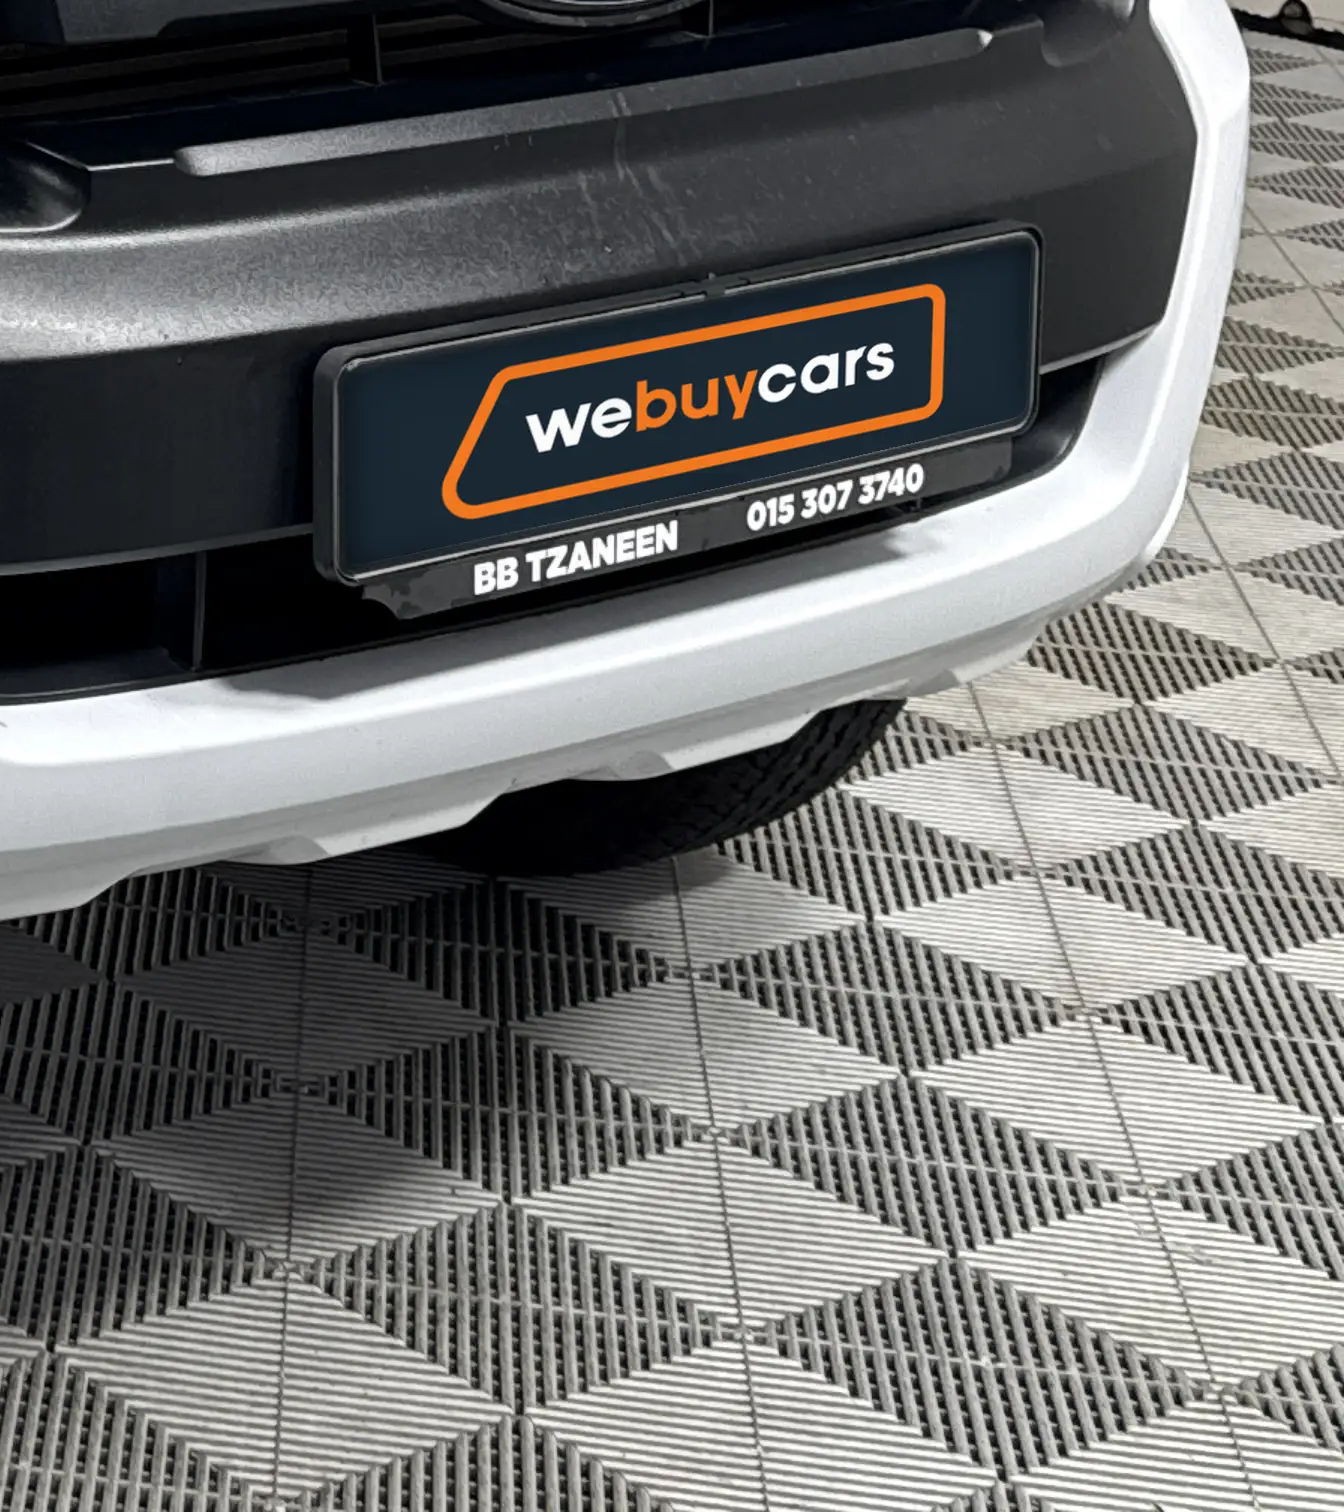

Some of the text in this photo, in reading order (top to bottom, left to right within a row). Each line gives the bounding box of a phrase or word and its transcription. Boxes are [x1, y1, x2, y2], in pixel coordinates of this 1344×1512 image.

[524, 341, 896, 454] webuycars
[473, 462, 925, 596] BB TZANEEN 015 307 3740
